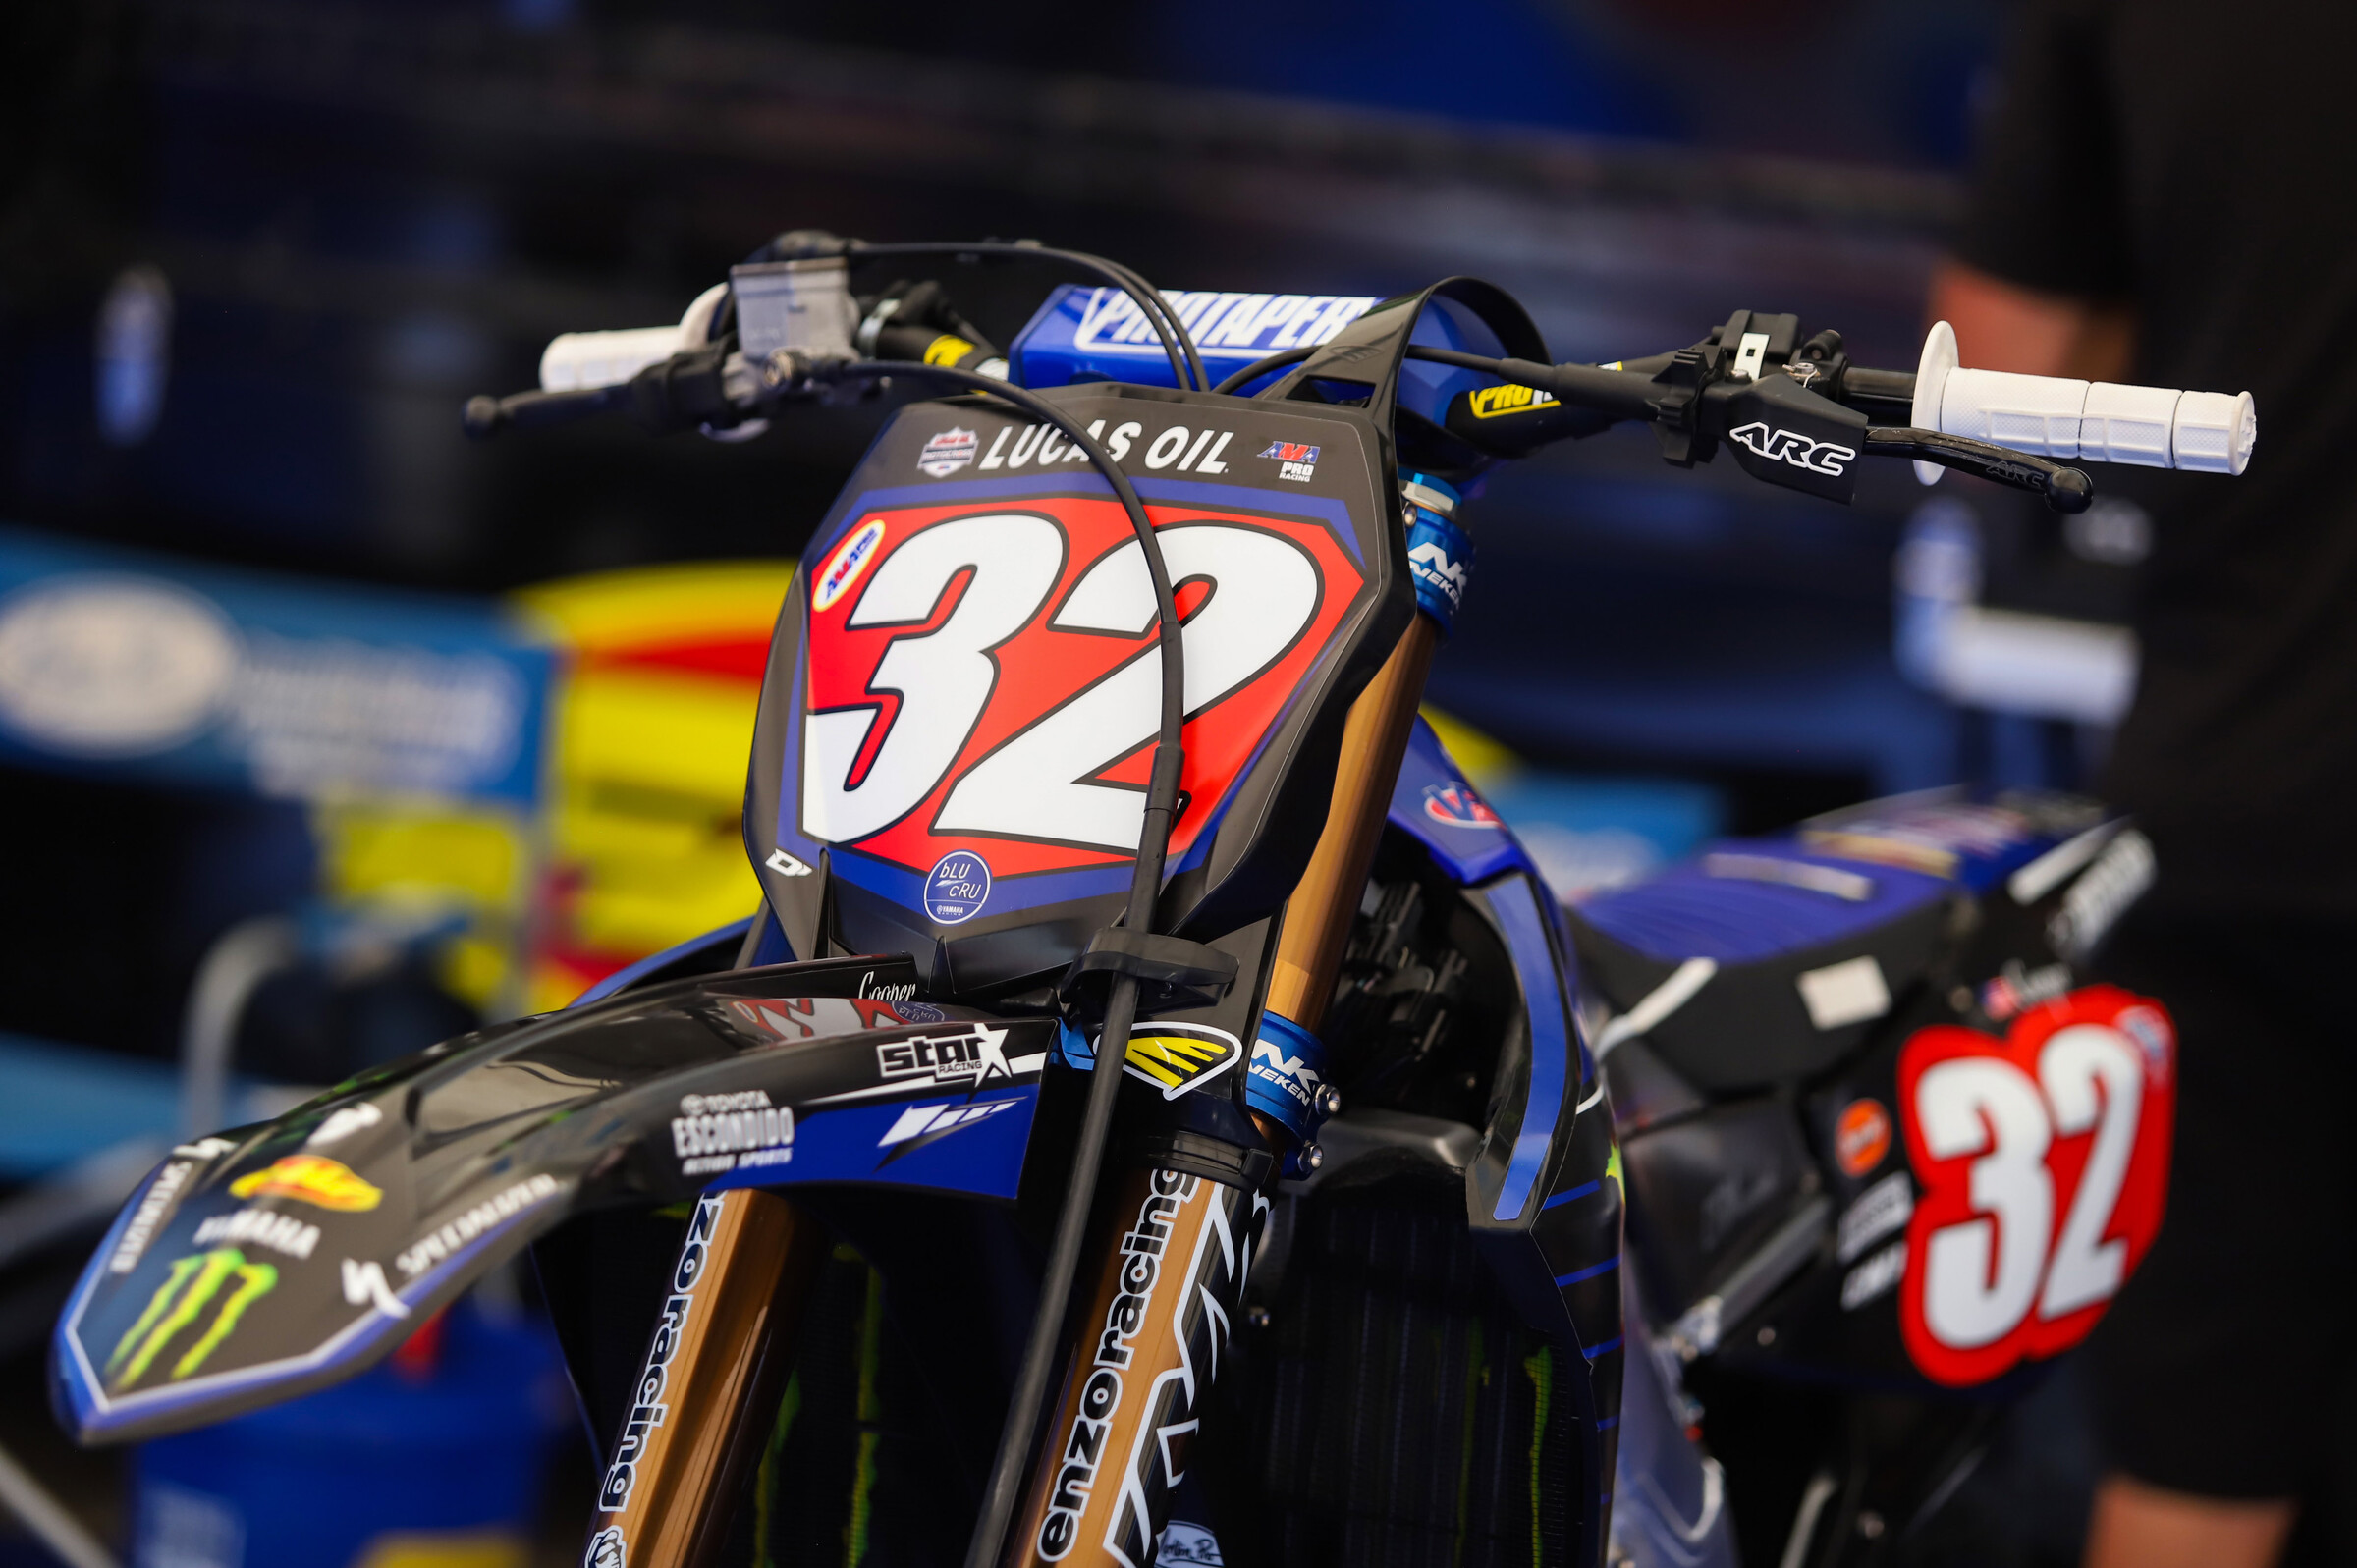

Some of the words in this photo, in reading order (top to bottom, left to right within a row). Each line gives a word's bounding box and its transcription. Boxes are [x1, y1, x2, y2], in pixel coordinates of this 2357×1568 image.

[1256, 440, 1321, 464] AMA
[1729, 421, 1856, 477] ARC
[1278, 472, 1311, 483] RACING
[1281, 461, 1314, 476] PRO
[800, 510, 1324, 853] 32
[939, 862, 971, 880] bLU
[949, 882, 982, 899] cRU
[938, 1061, 983, 1074] RACING
[672, 1106, 795, 1158] ESCONDIDO
[1914, 1022, 2147, 1350] 32
